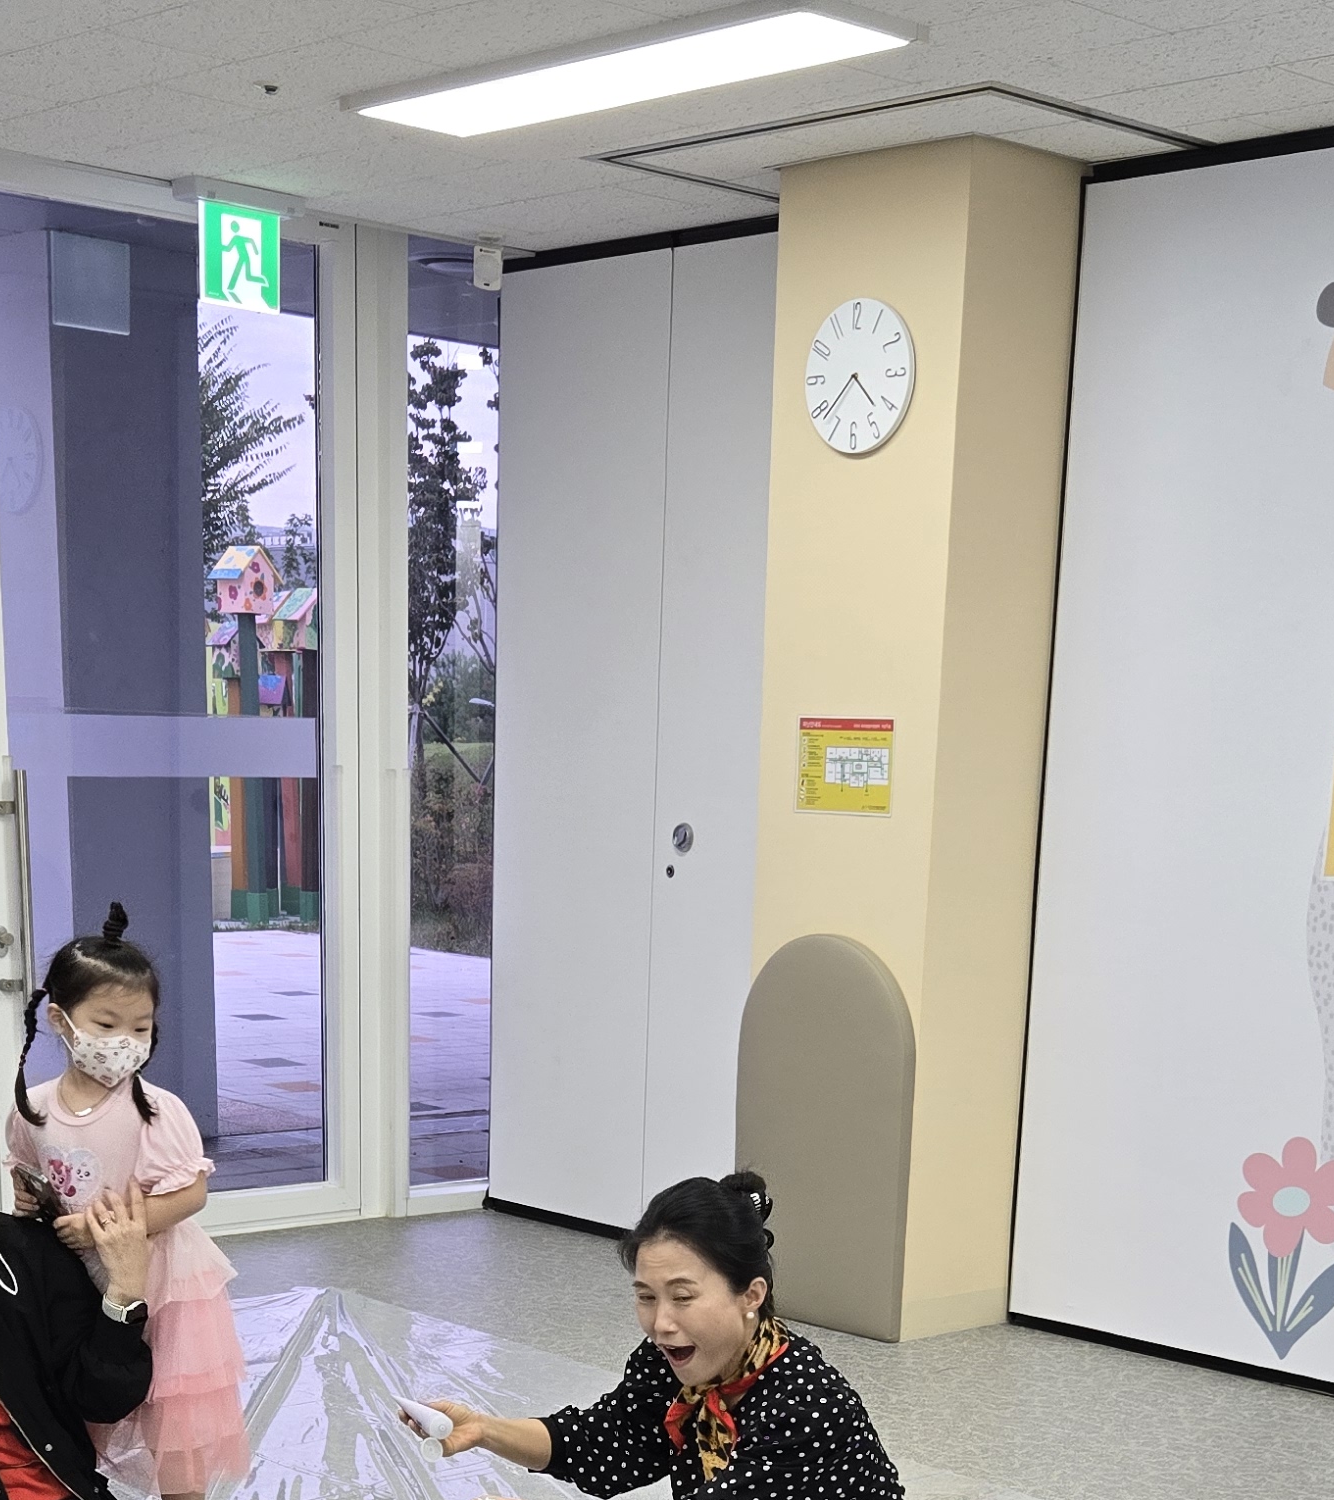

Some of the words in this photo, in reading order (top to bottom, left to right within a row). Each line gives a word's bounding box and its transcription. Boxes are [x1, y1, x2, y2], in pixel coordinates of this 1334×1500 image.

[853, 302, 862, 330] 12
[812, 339, 831, 361] 10
[882, 332, 901, 353] 2
[806, 374, 826, 386] 9
[885, 367, 906, 378] 3
[811, 400, 829, 419] 8
[880, 396, 898, 412] 4
[828, 415, 841, 441] 7
[850, 422, 857, 450] 6
[867, 412, 880, 439] 5
